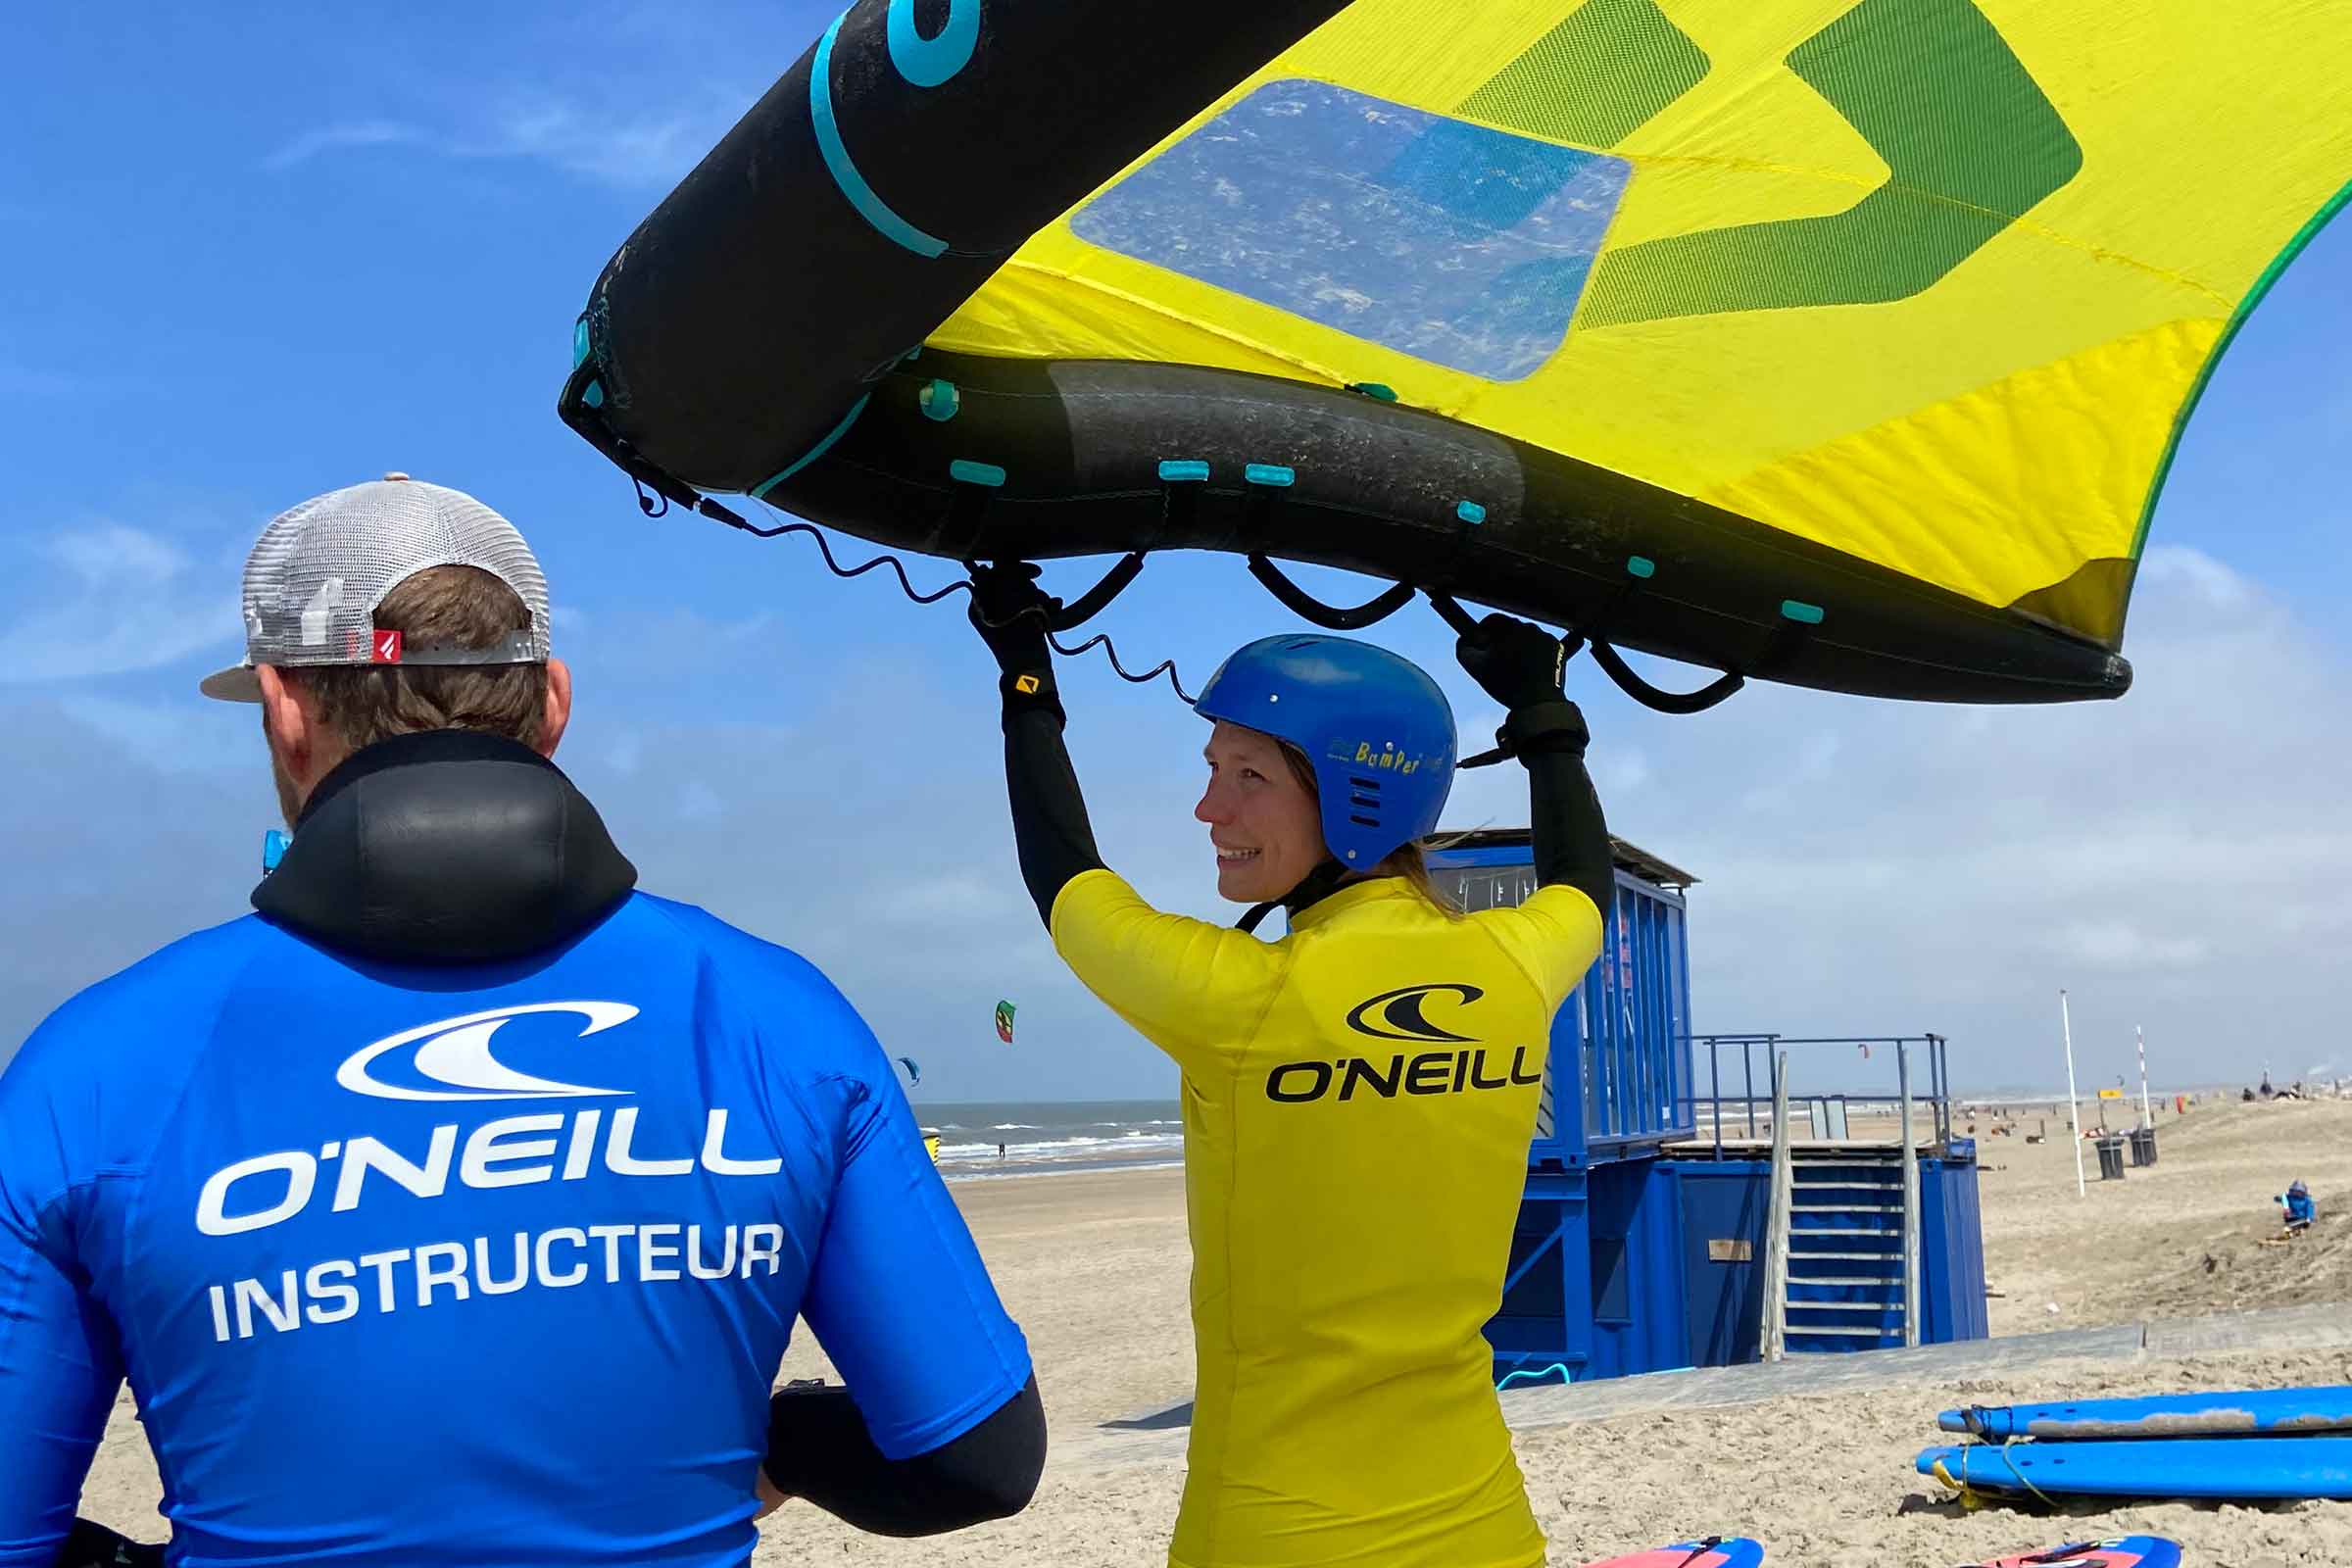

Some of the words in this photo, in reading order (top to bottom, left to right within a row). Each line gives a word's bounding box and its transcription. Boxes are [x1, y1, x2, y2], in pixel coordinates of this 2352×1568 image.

[1266, 1046, 1542, 1102] O'NEILL
[196, 1107, 784, 1236] O'NEILL
[209, 1222, 785, 1343] INSTRUCTEUR
